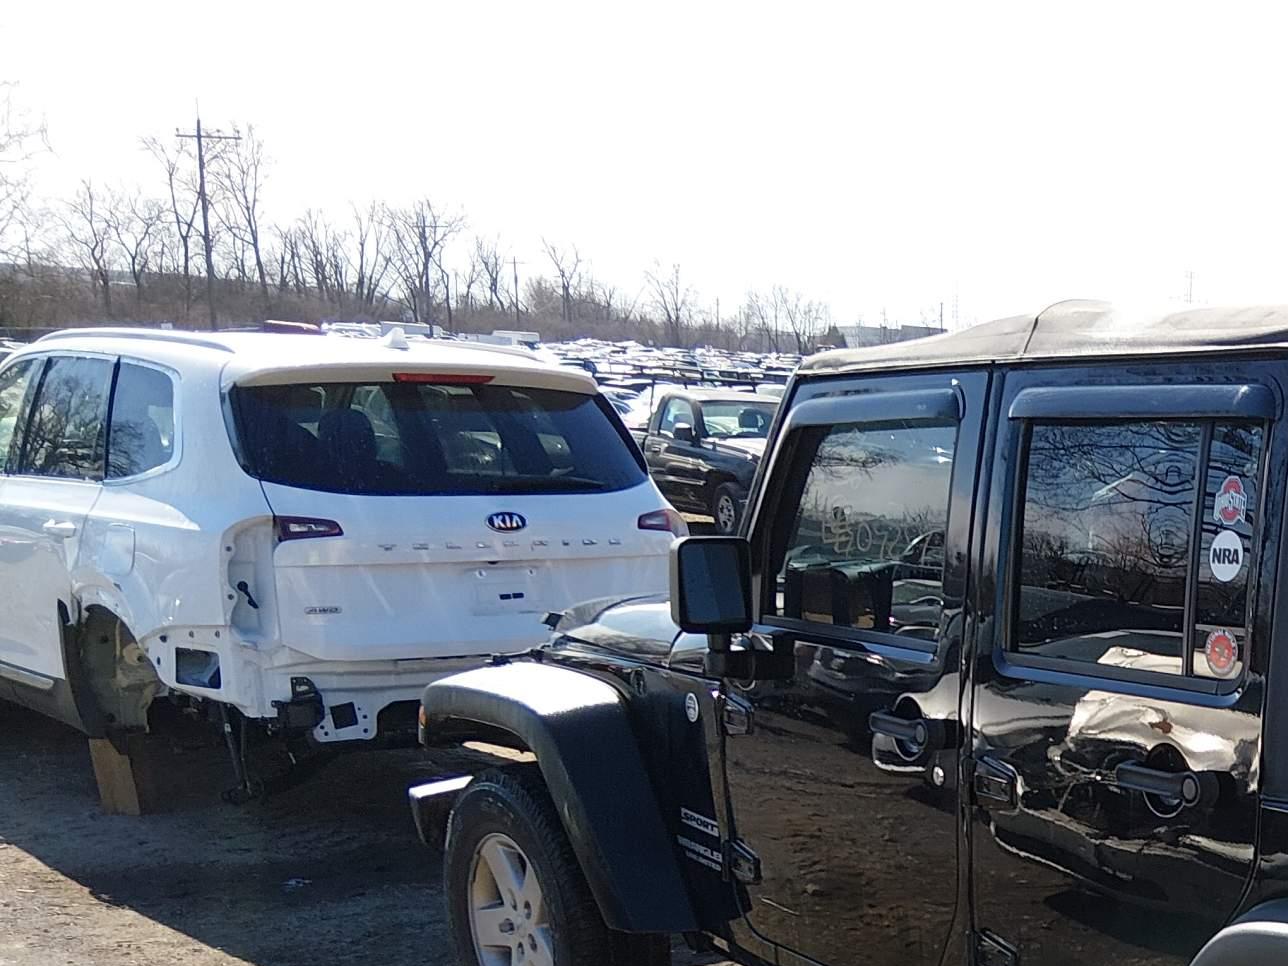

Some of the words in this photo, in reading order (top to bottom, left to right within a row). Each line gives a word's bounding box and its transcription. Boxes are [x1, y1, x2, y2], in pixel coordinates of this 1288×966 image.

[492, 513, 523, 529] KIA
[1212, 547, 1240, 565] NRA
[681, 809, 719, 835] SPORT
